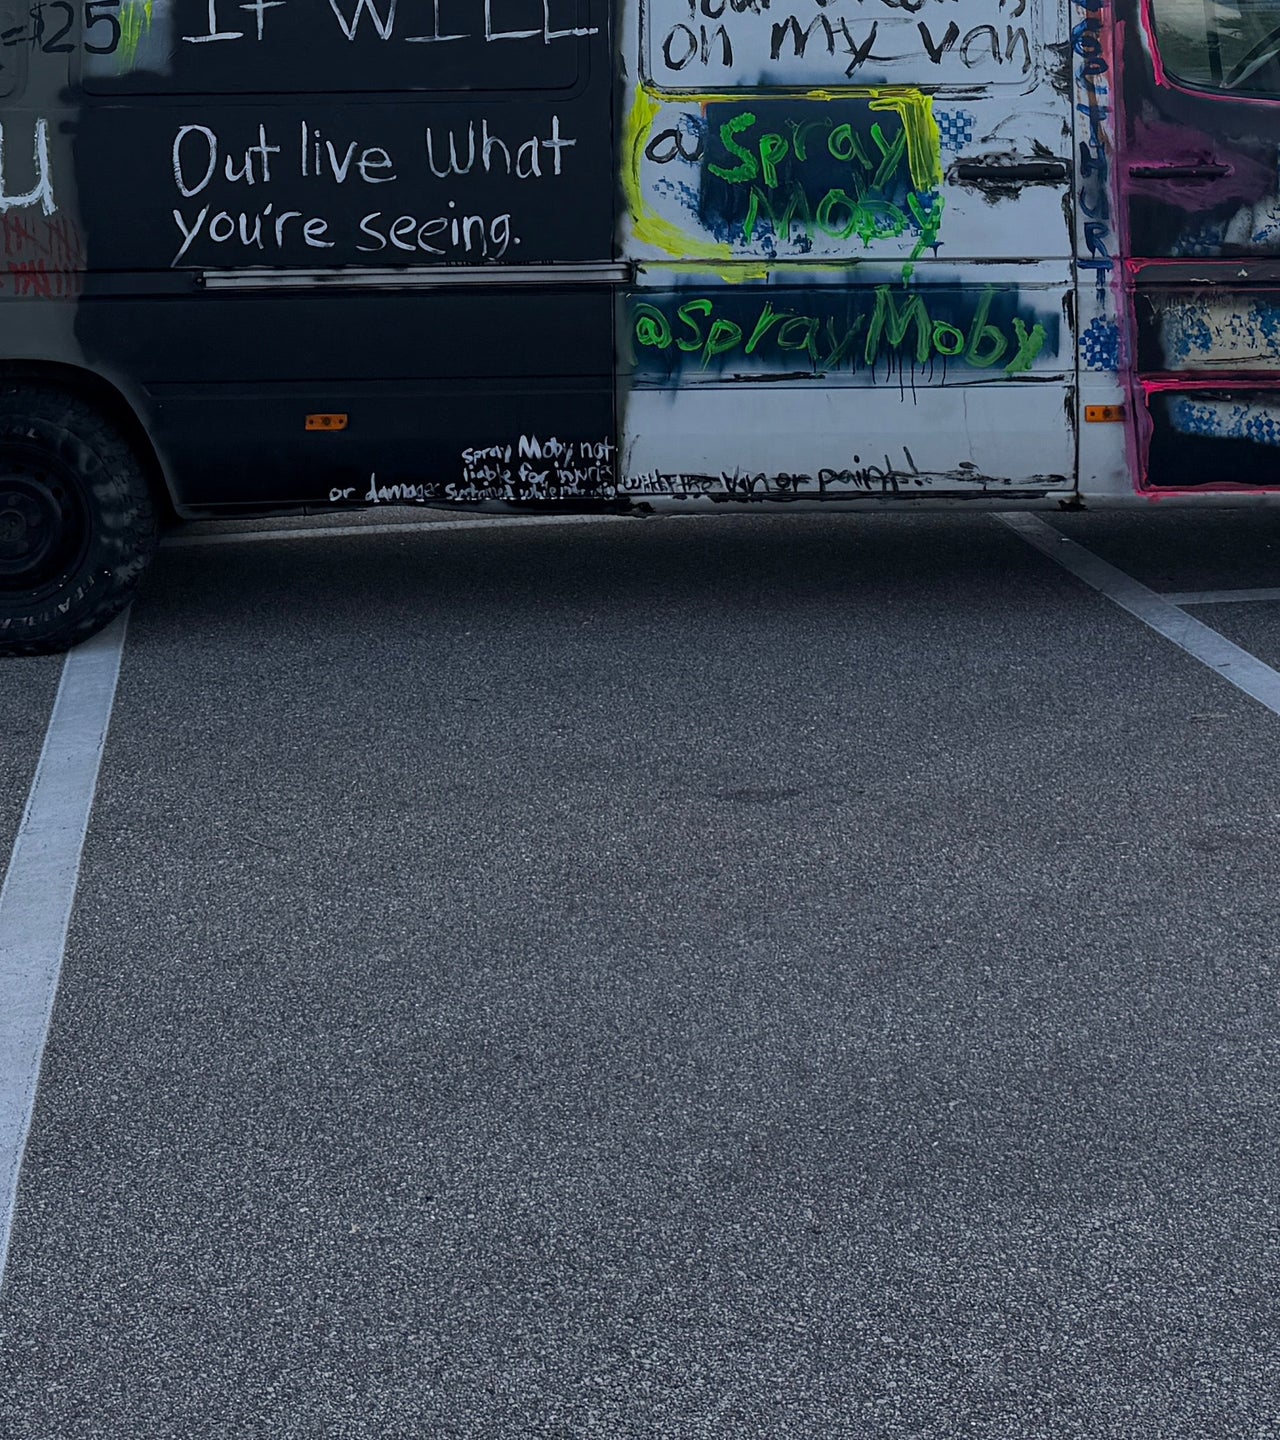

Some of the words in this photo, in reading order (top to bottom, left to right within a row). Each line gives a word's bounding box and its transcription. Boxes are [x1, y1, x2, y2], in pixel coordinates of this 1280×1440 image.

[425, 114, 577, 179] What
[707, 111, 908, 192] Spray
[170, 202, 336, 269] you're
[355, 200, 521, 262] seeing.
[518, 461, 550, 484] for
[519, 433, 574, 468] Moby
[329, 486, 357, 502] or
